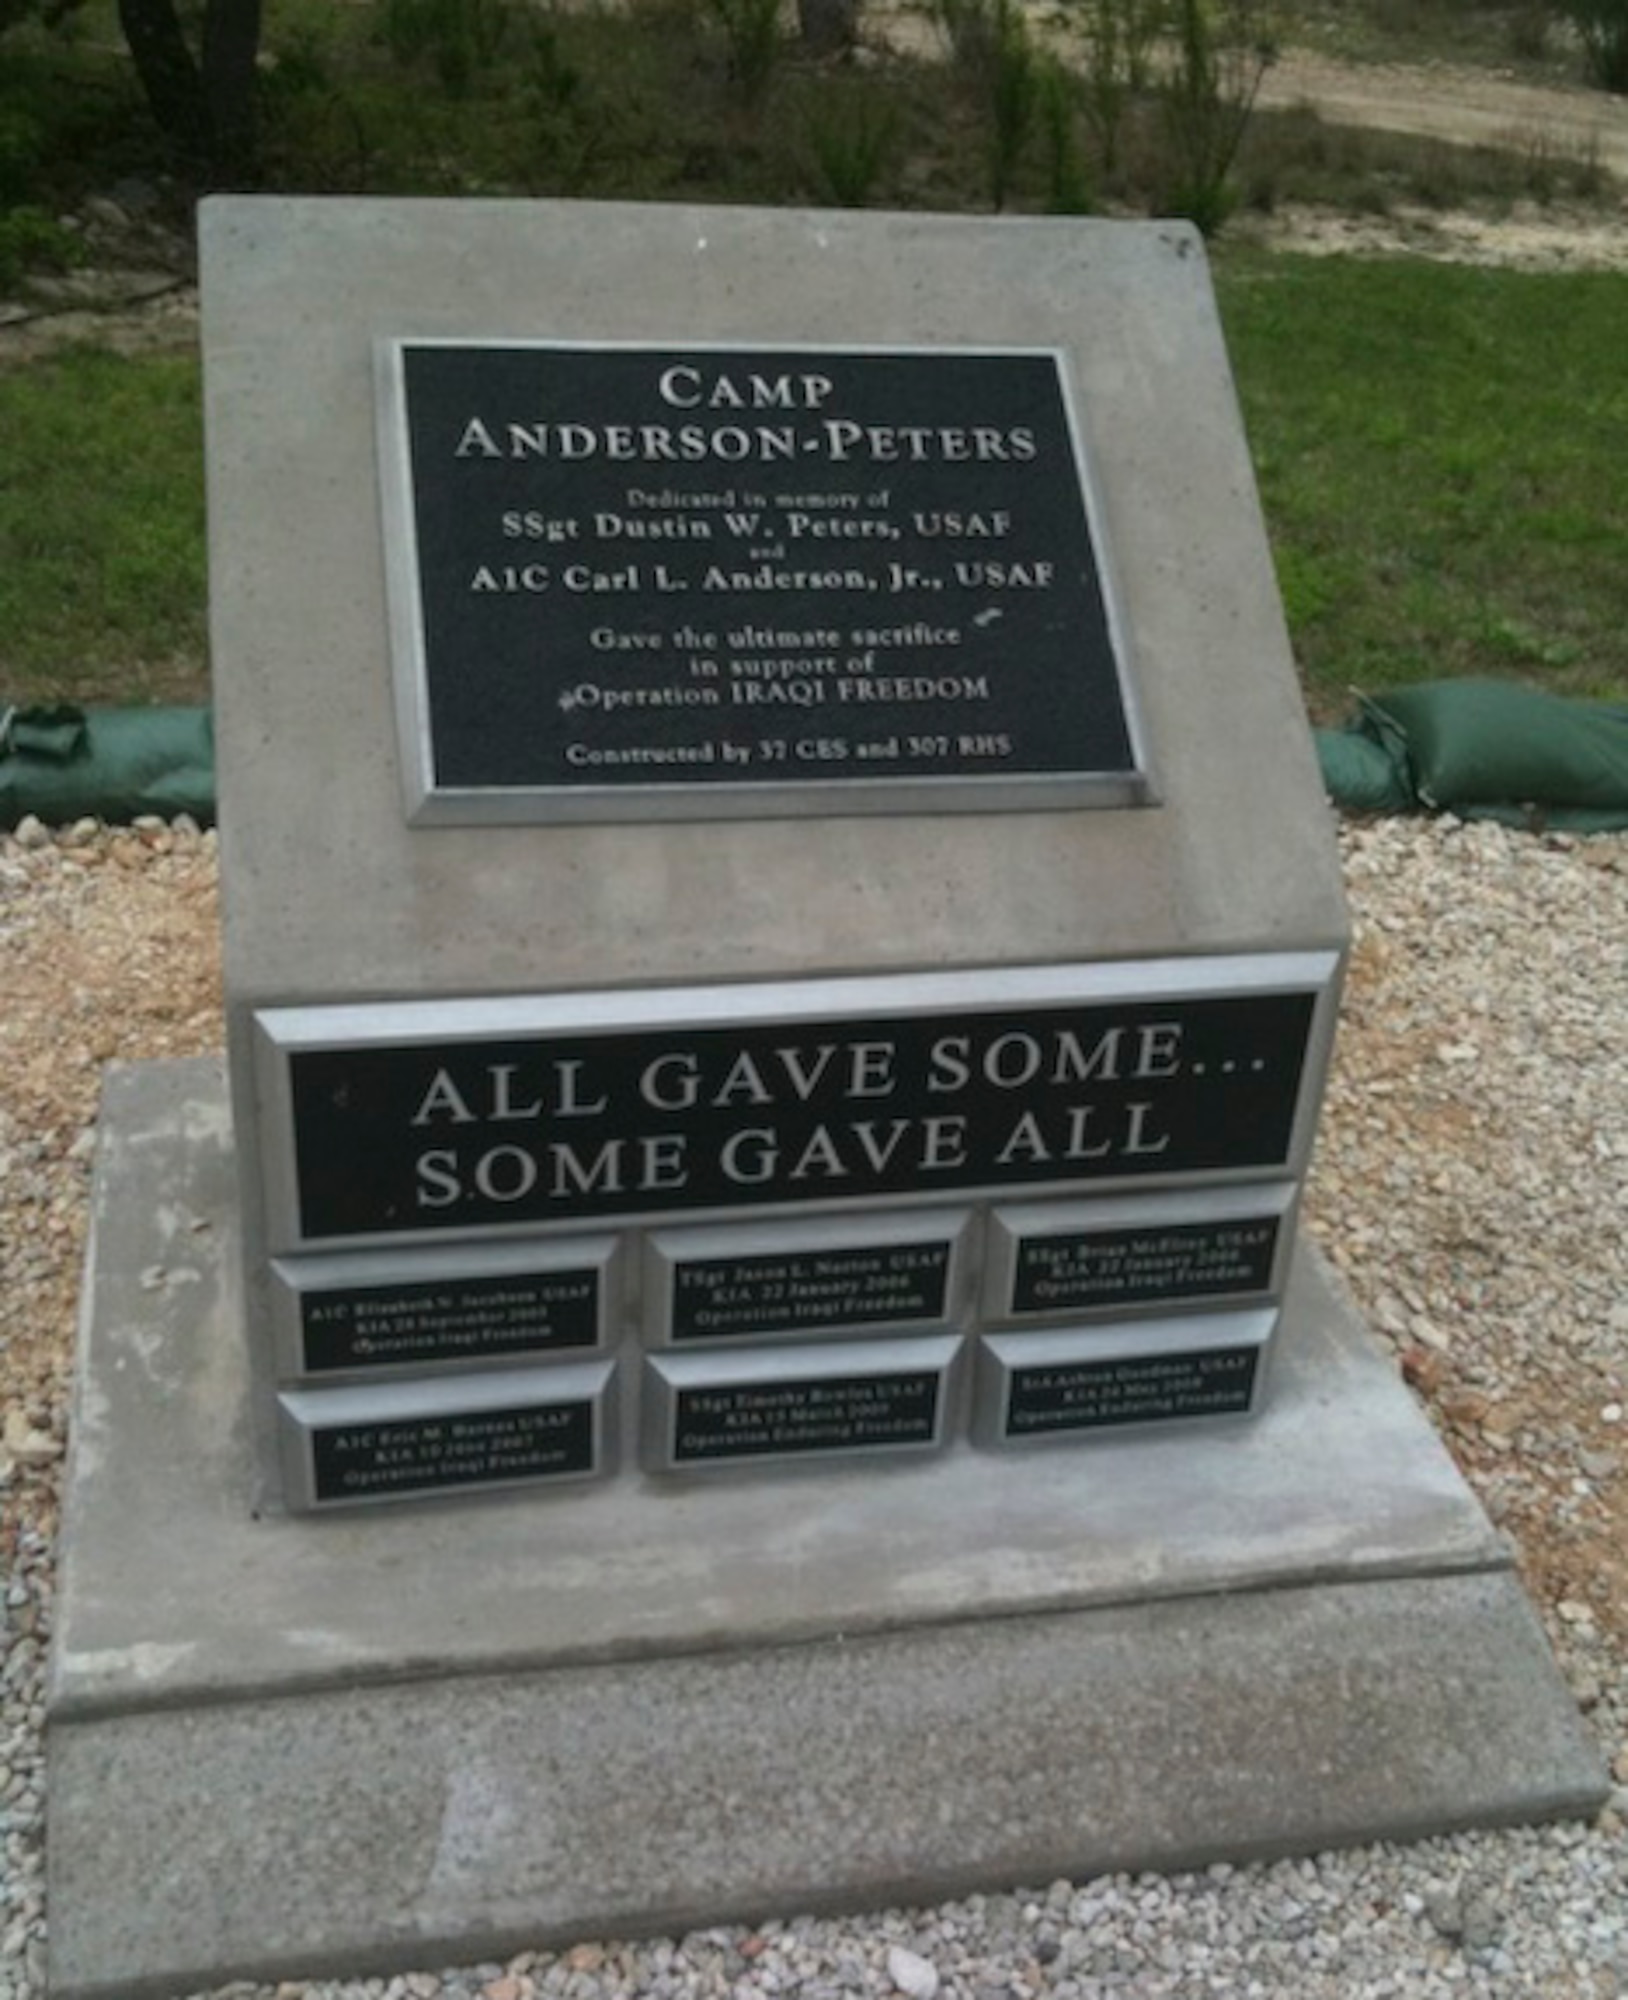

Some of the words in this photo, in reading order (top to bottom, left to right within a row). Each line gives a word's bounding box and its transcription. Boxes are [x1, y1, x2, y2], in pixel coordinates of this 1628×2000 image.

[659, 365, 833, 408] CAMP
[454, 417, 1037, 460] ANDERSON-PETERS
[627, 489, 735, 508] Dedicated
[743, 490, 767, 507] in
[775, 491, 860, 509] memory
[867, 489, 890, 507] of
[502, 510, 579, 542] SSgt
[594, 513, 711, 538] Dustin
[723, 513, 774, 538] W.
[787, 513, 900, 540] Peters,
[912, 510, 1011, 537] USAF
[750, 544, 784, 559] and
[471, 564, 549, 592] A1C
[563, 564, 639, 591] Carl
[654, 565, 687, 592] L.
[702, 565, 878, 591] Anderson,
[888, 561, 944, 592] Jr.,
[955, 561, 1054, 587] USAF
[590, 627, 662, 649] Gave
[673, 625, 717, 649] the
[727, 624, 840, 649] ultimate
[851, 621, 961, 646] sacrifice
[690, 655, 719, 676] in
[730, 656, 836, 679] support
[847, 650, 875, 673] of
[575, 683, 719, 711] Operation
[731, 680, 825, 707] IRAQI
[837, 676, 989, 701] FREEDOM
[566, 741, 715, 766] Constructed
[721, 741, 750, 764] by
[760, 739, 787, 760] 37
[796, 738, 848, 760] CES
[857, 736, 898, 758] and
[411, 1060, 608, 1126] ALL
[640, 1042, 897, 1110] GAVE
[417, 1135, 689, 1207] SOME
[720, 1115, 968, 1184] GAVE
[995, 1103, 1171, 1163] ALL
[787, 1278, 858, 1297] January
[1034, 1279, 1125, 1297] Operation
[1175, 1266, 1253, 1283] Freedom
[695, 1307, 790, 1326] Operation
[795, 1302, 839, 1318] Iraqi
[844, 1295, 923, 1312] Freedom
